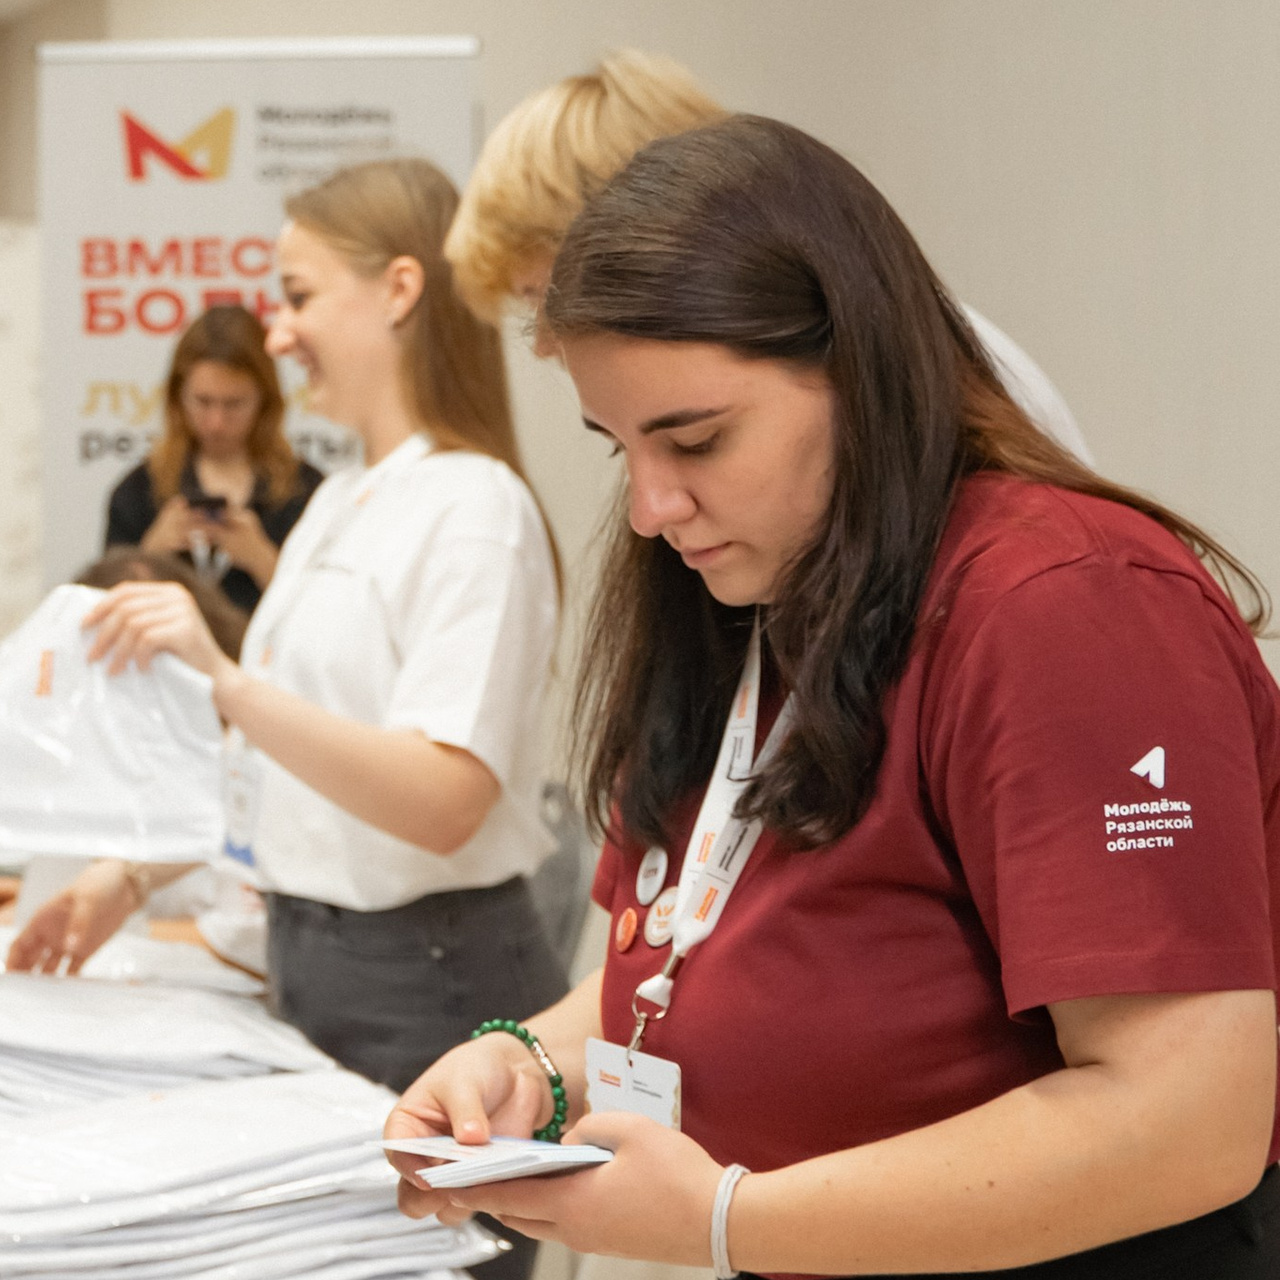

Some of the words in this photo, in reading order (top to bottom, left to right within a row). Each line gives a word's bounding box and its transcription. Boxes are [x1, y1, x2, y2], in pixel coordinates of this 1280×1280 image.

[81, 237, 277, 278] ВМЕС
[1104, 798, 1191, 817] Молодёжь
[1105, 815, 1193, 834] Рязанской
[1106, 837, 1174, 851] области
